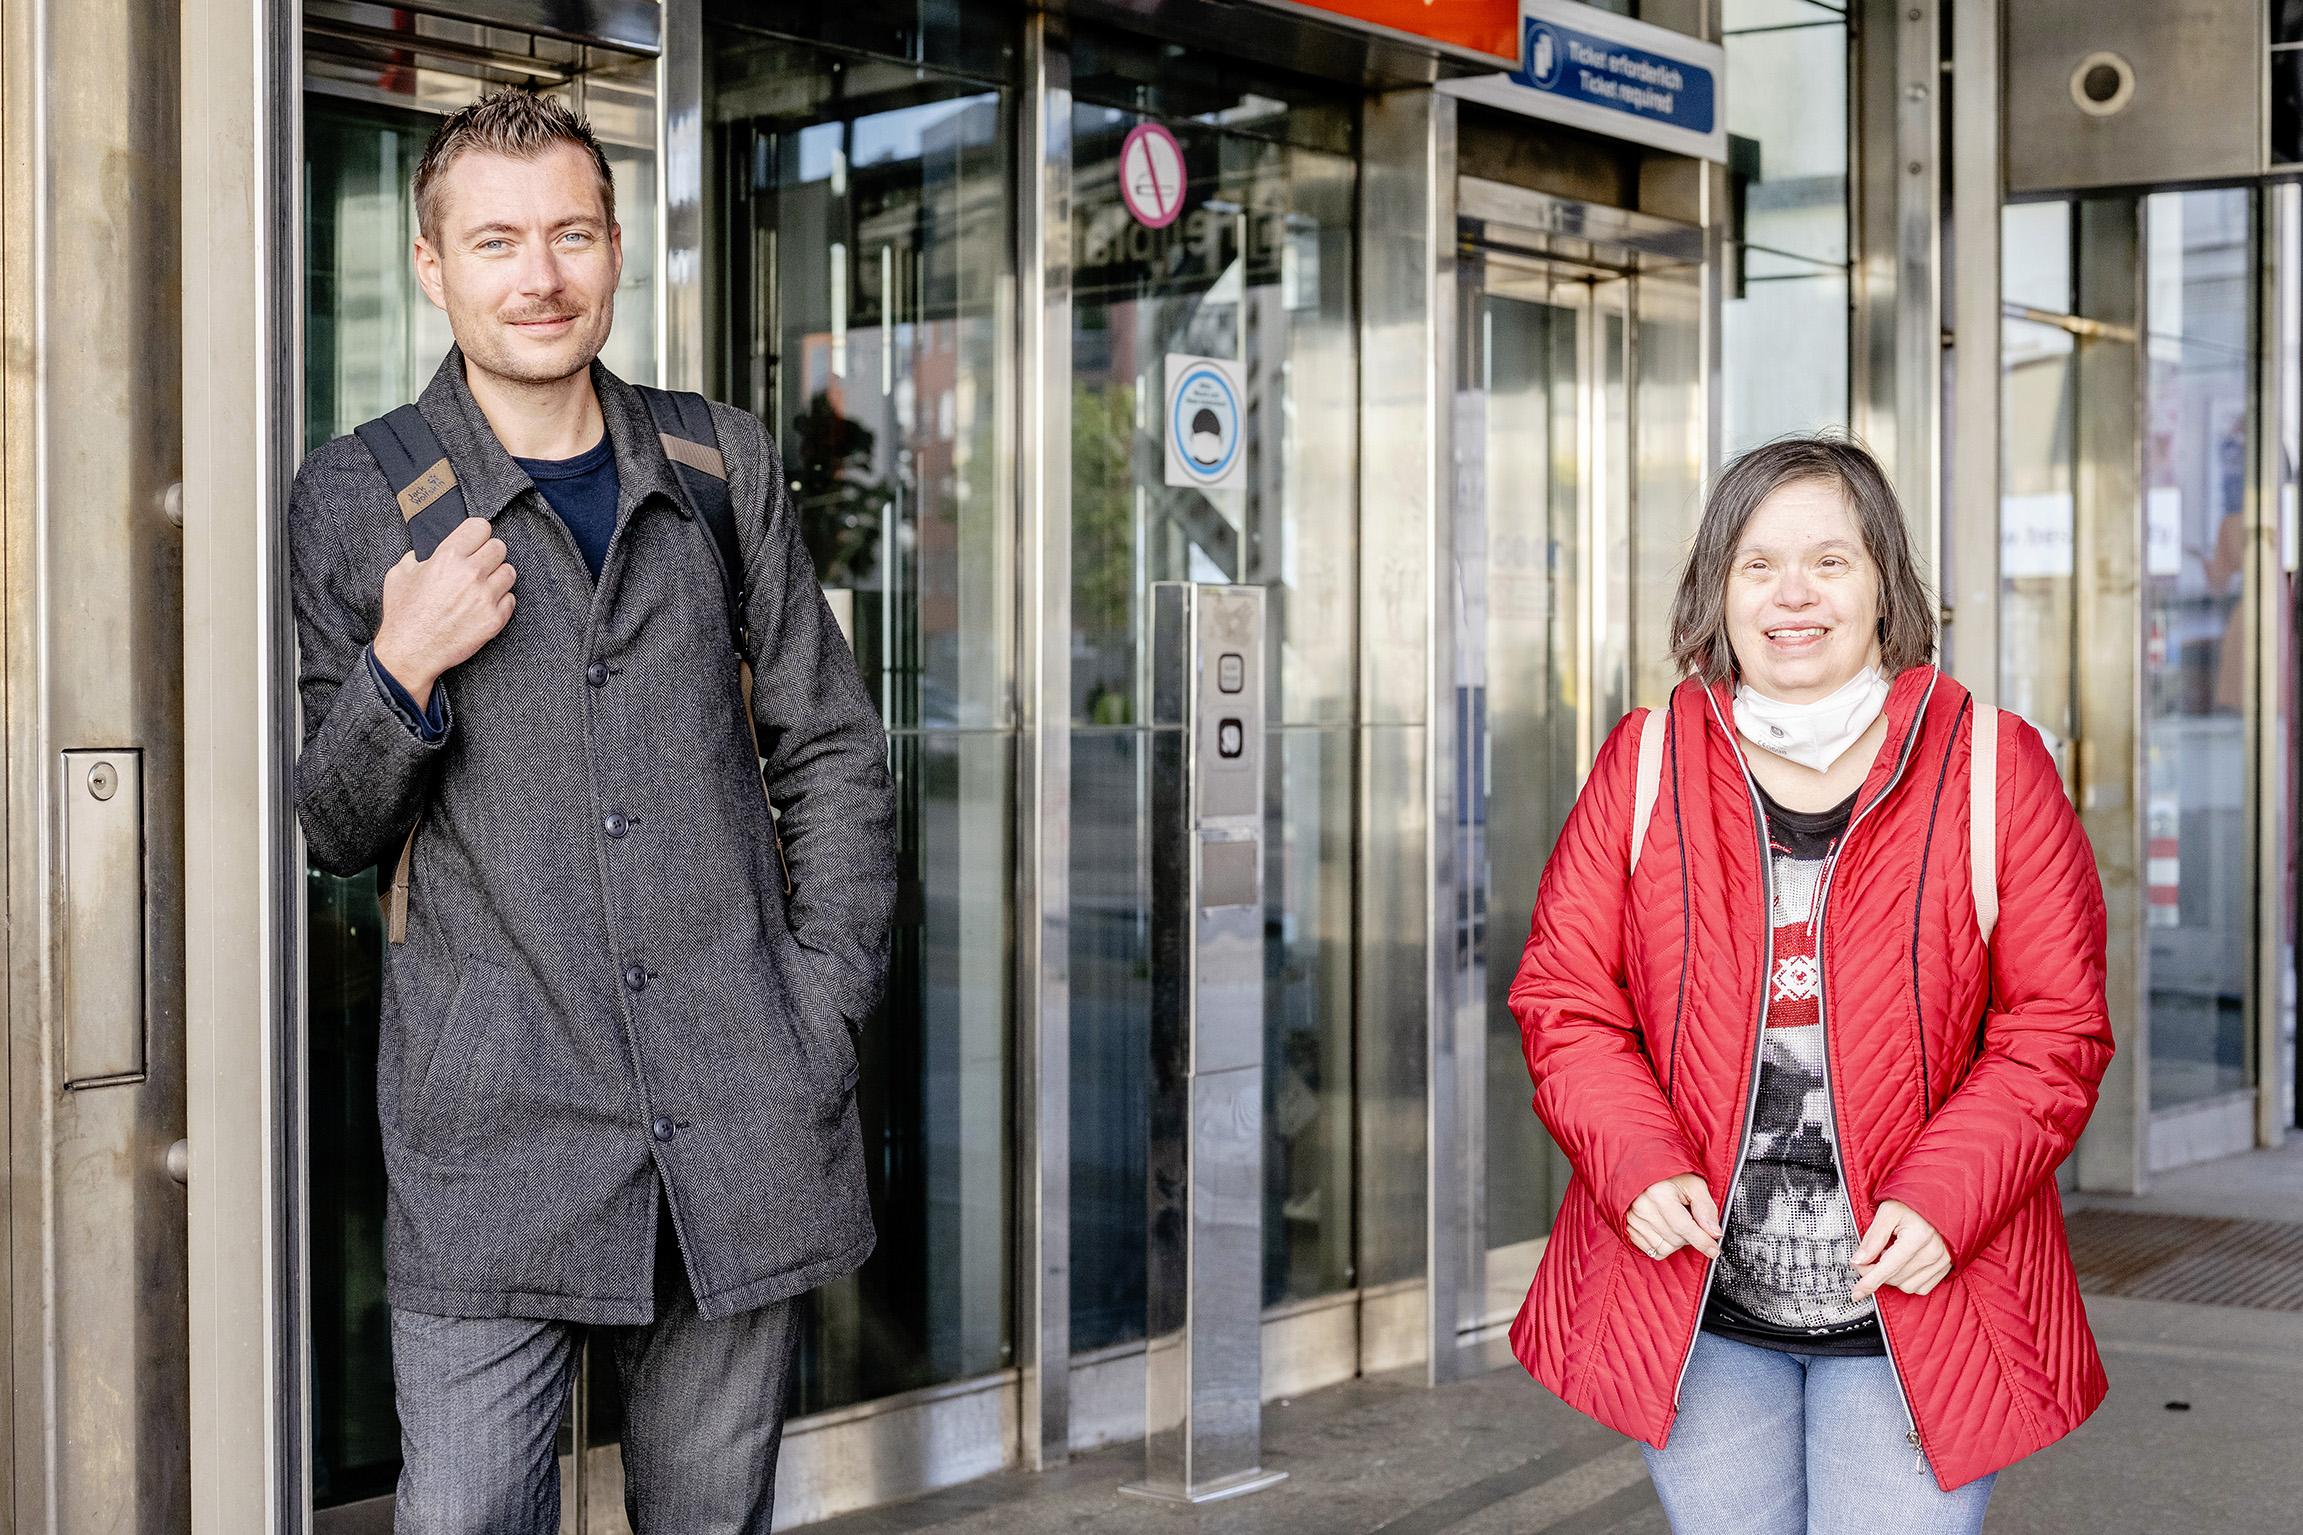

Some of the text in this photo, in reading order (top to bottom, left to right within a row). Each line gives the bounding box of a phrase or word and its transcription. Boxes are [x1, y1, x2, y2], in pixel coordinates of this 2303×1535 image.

[1568, 41, 1684, 91] Ticket erforderlich
[1578, 69, 1674, 114] Ticket required
[408, 486, 427, 501] Jack
[411, 480, 446, 505] Wolfskin
